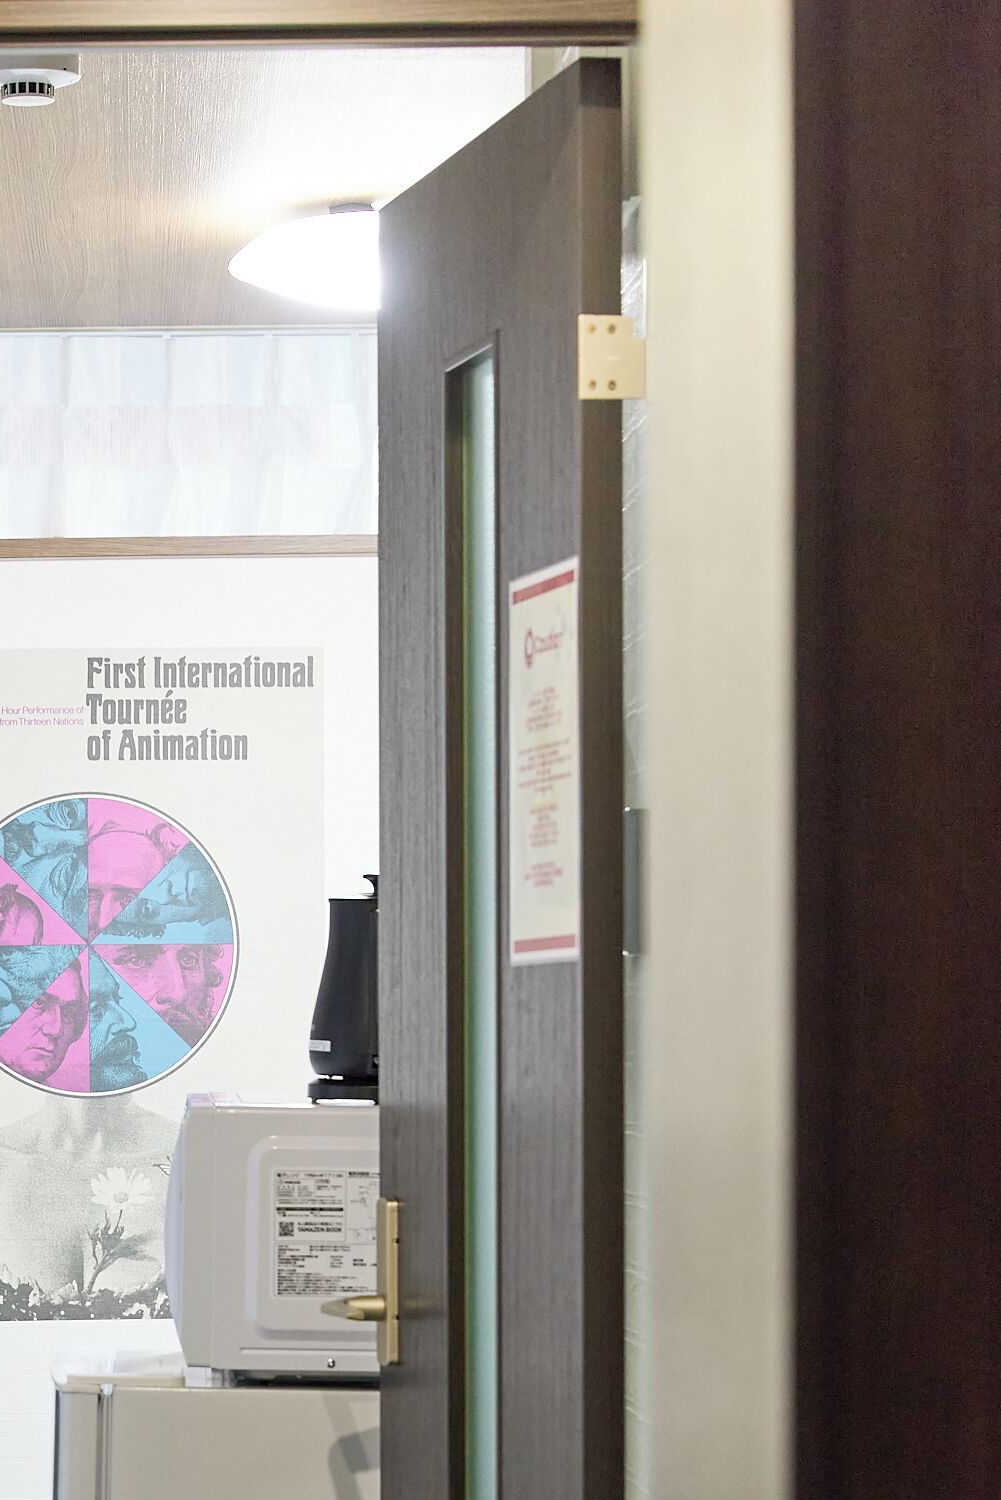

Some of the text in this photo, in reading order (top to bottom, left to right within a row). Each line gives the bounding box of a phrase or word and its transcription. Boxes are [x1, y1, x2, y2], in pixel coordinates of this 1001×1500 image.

[87, 655, 314, 688] First International
[0, 718, 18, 727] from
[19, 717, 52, 726] Thirteen
[53, 717, 84, 726] Nations
[22, 706, 74, 714] Performance
[76, 706, 84, 714] of
[86, 690, 188, 724] Tournée
[87, 728, 248, 761] of Animation
